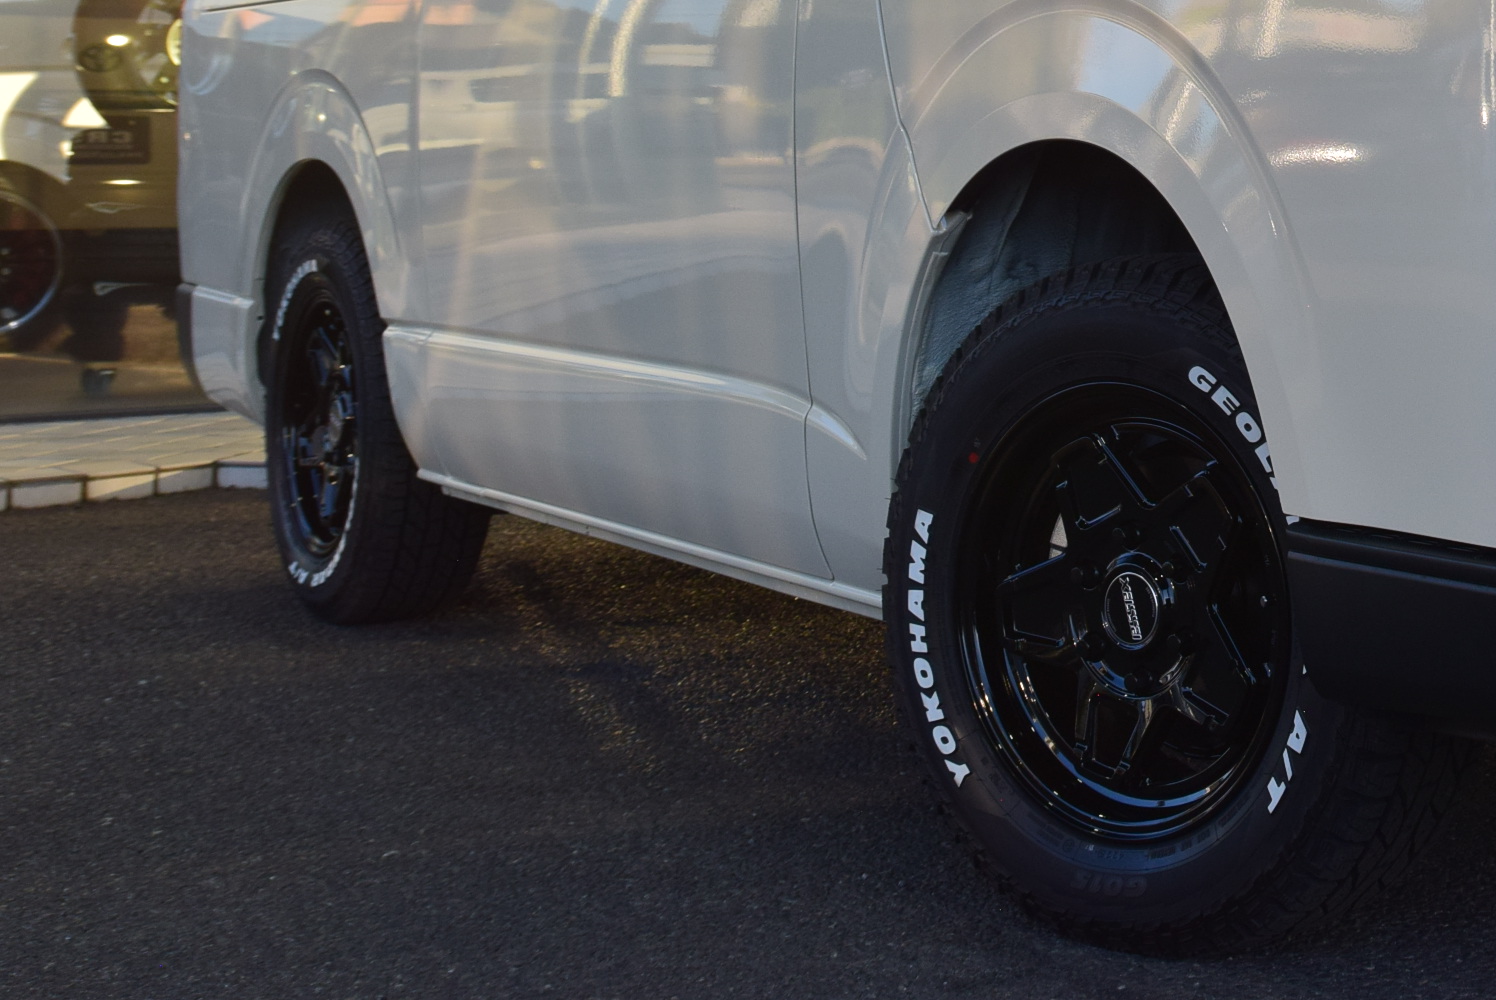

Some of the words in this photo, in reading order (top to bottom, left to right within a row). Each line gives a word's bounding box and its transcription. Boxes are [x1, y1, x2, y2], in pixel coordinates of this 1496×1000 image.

[1187, 365, 1279, 490] GEOL
[907, 508, 971, 788] YOKOHAMA
[1267, 708, 1309, 814] A/T
